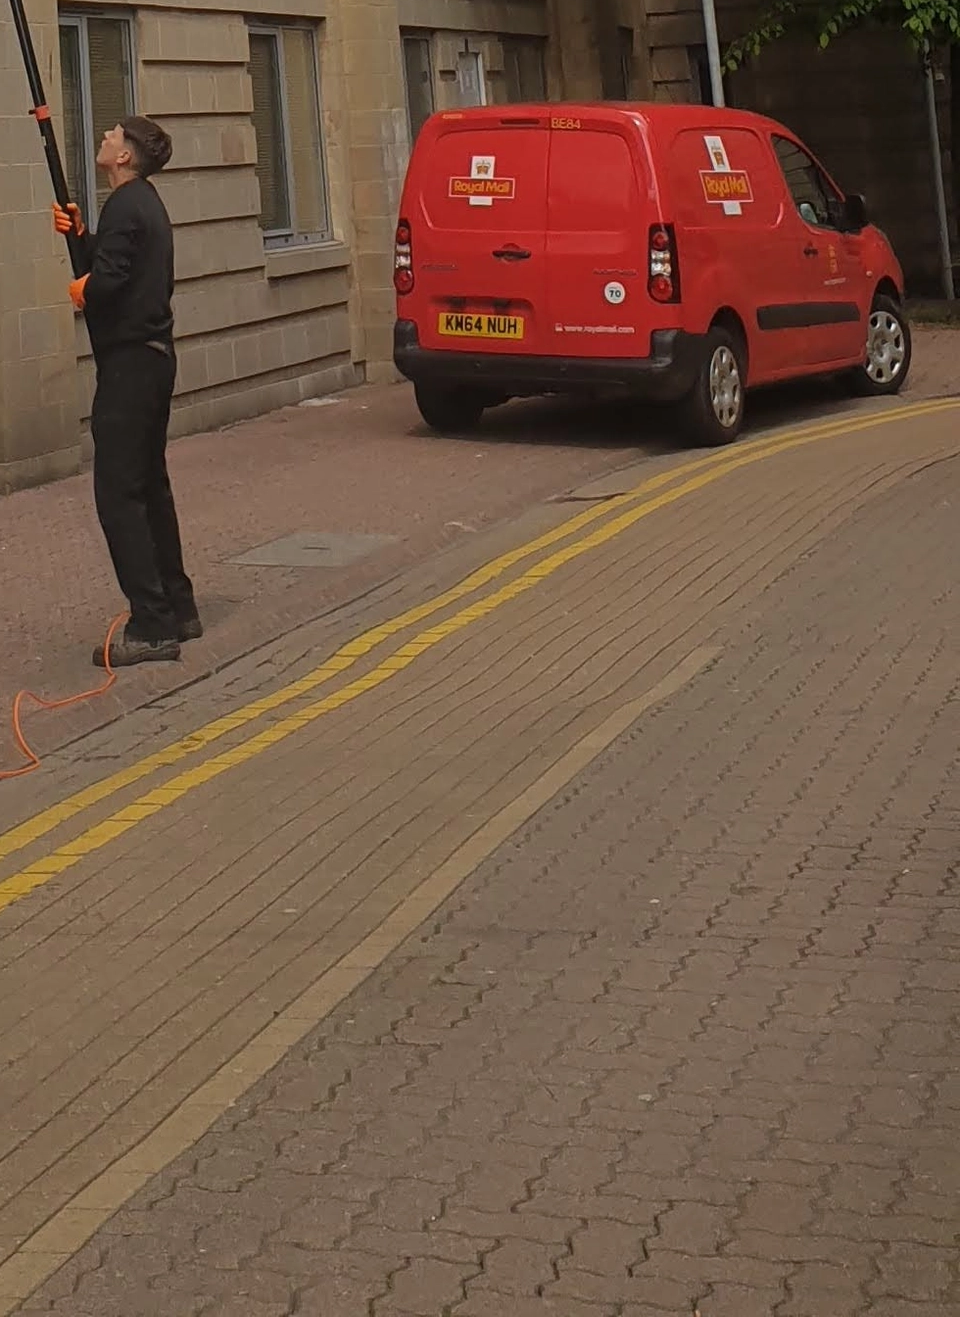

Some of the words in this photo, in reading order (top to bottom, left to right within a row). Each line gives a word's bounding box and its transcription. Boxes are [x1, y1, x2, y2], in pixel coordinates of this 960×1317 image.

[454, 181, 484, 194] Royal
[486, 182, 510, 193] Mail
[704, 175, 731, 198] Royal
[609, 289, 621, 298] 70
[487, 316, 517, 334] NUH
